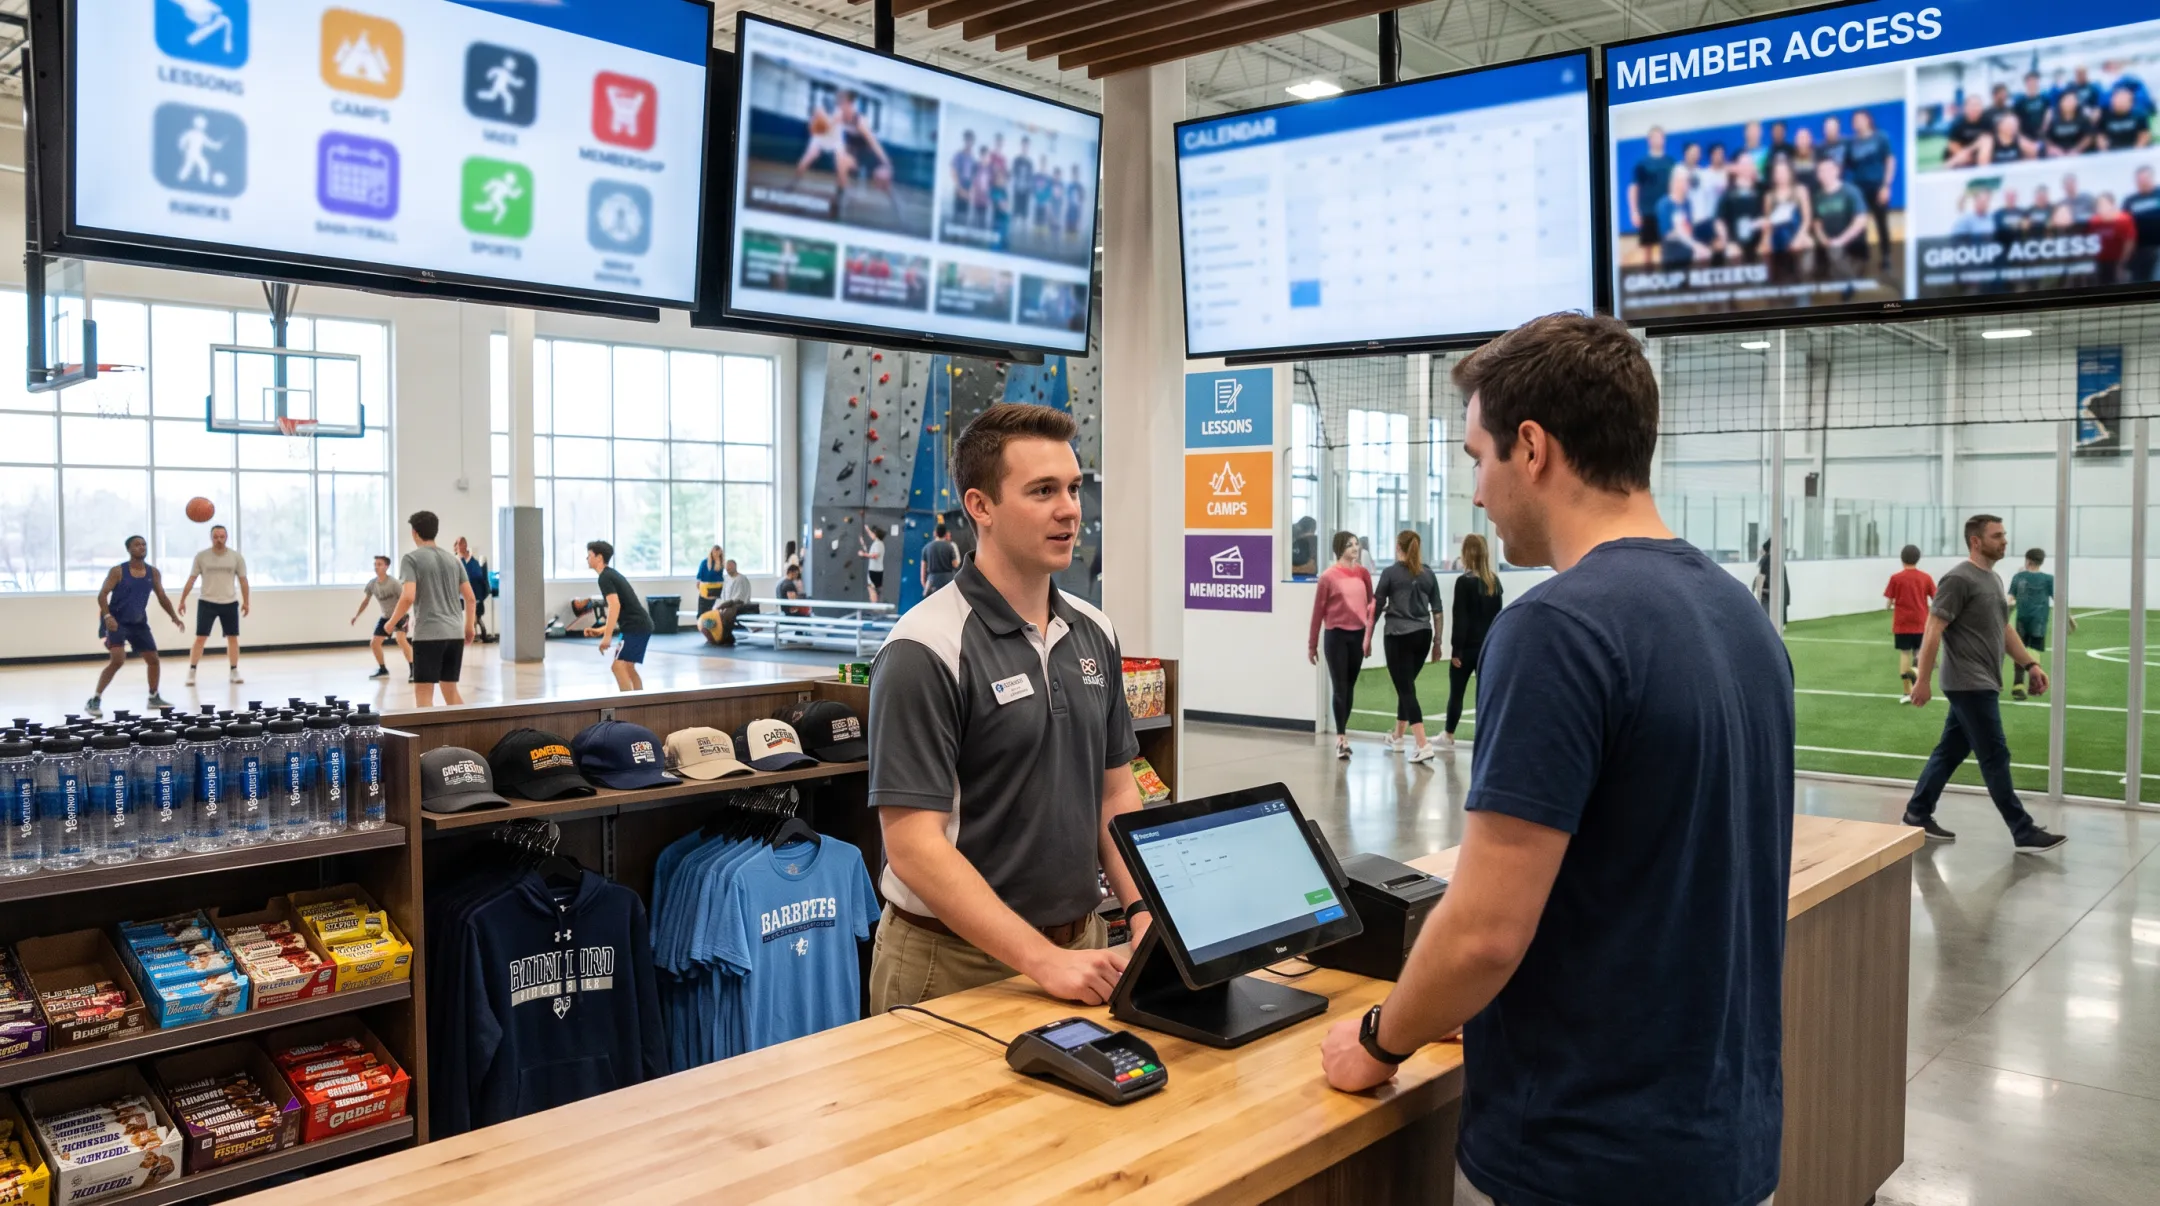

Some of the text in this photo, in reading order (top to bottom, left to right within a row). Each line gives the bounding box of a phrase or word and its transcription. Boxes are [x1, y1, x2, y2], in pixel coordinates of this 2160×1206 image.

[1617, 7, 1942, 90] MEMBER ACCESS
[158, 65, 244, 96] LESSONS
[330, 99, 391, 124] CAMPS
[1184, 117, 1277, 151] CALENDAR
[1923, 234, 2102, 268] GROUP ACCESS
[1201, 418, 1252, 436] LESSONS
[1206, 501, 1248, 516] CAMPS
[1189, 582, 1266, 599] MEMBERSHIP
